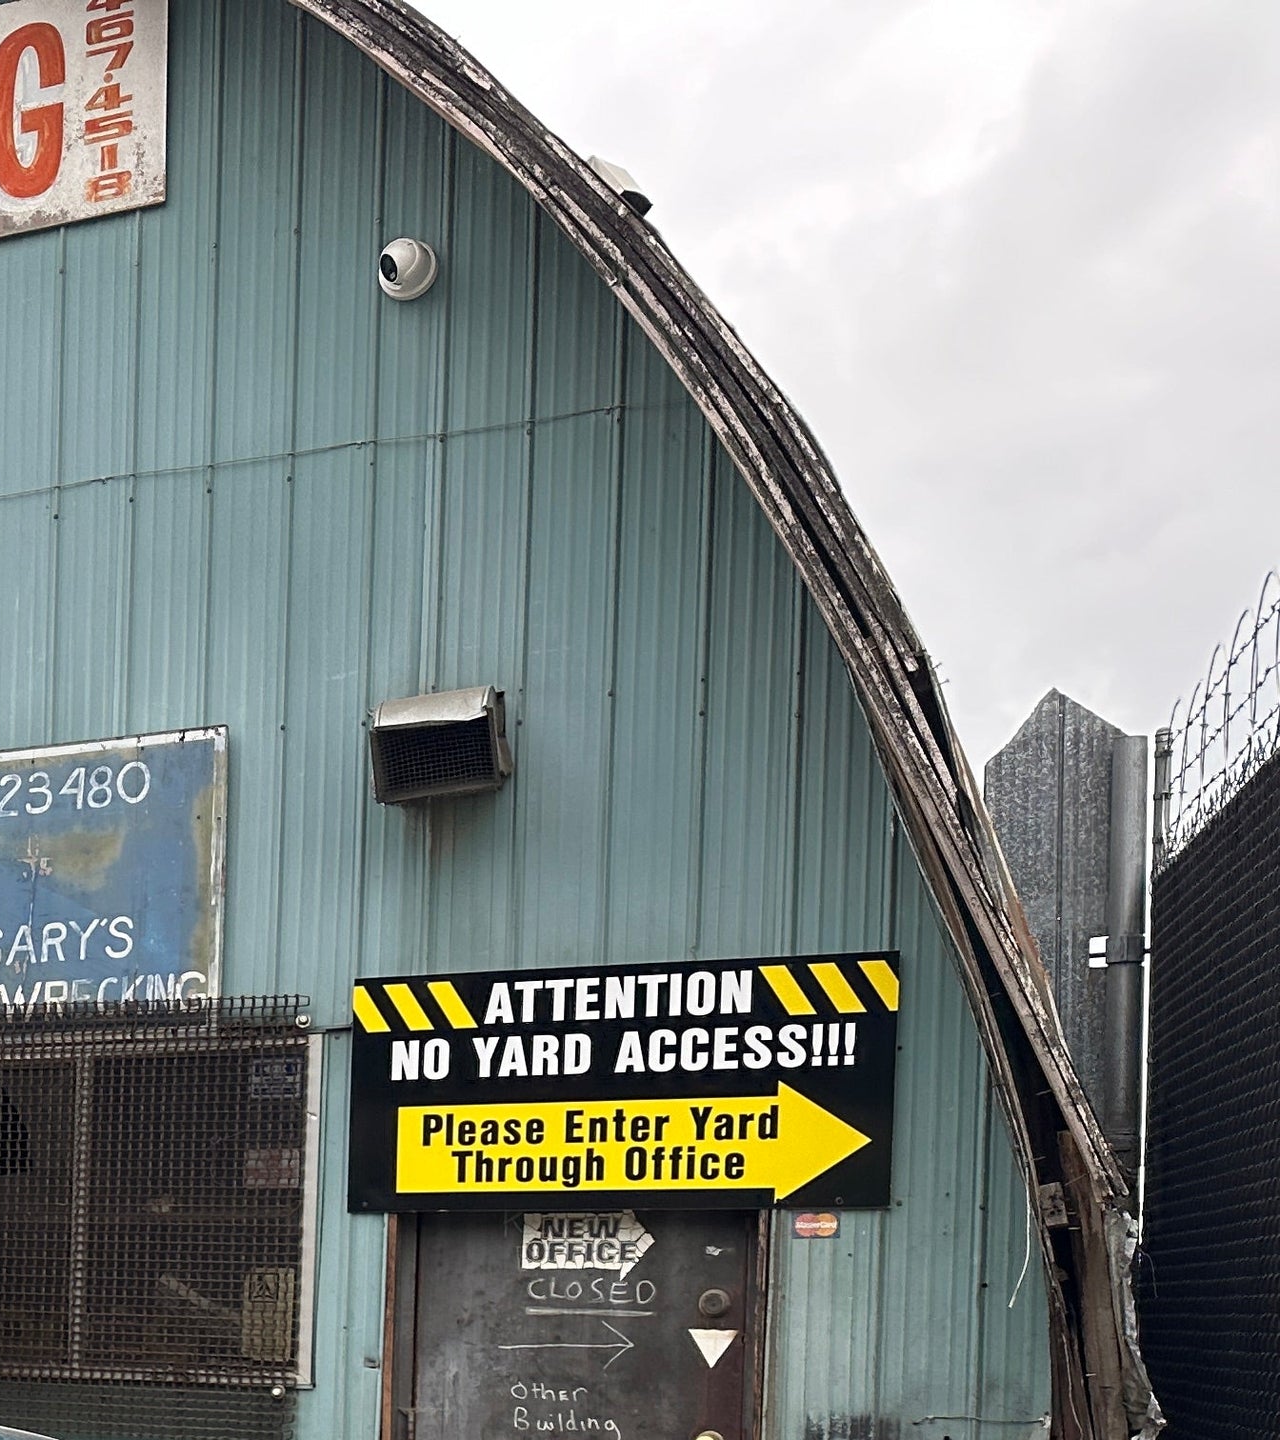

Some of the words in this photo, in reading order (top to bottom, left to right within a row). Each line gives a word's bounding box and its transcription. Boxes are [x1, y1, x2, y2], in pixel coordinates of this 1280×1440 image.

[483, 969, 753, 1025] ATTENTION
[391, 1039, 452, 1081] NO
[472, 1032, 592, 1078] YARD
[614, 1021, 857, 1073] ACCESS!!!
[421, 1113, 545, 1147] Please
[565, 1108, 670, 1144] Enter
[689, 1104, 779, 1141] Yard
[451, 1147, 605, 1188] Through
[624, 1146, 746, 1181] Office
[542, 1216, 619, 1239] NEW
[526, 1238, 637, 1263] OFFICE
[528, 1277, 656, 1304] CLOSED
